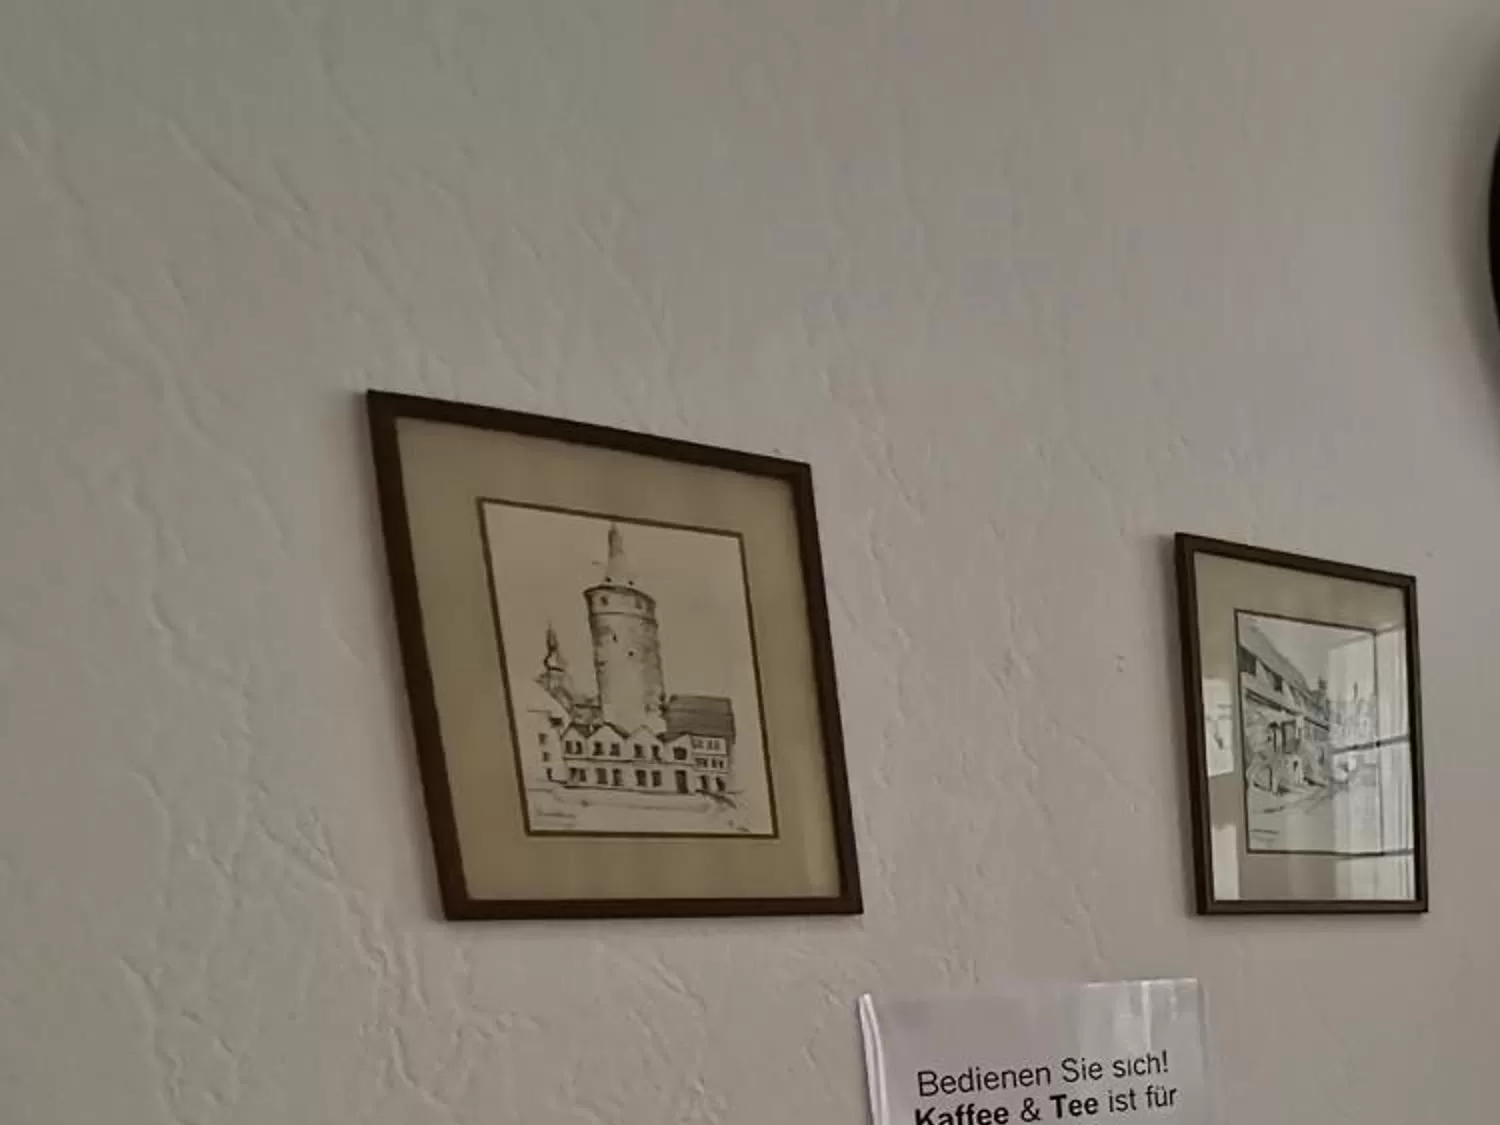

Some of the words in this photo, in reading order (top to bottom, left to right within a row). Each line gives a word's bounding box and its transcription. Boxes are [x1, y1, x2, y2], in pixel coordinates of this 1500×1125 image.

[917, 1064, 1052, 1098] Bedienen
[1060, 1056, 1104, 1084] Sie
[1112, 1050, 1170, 1078] sich!
[1019, 1096, 1042, 1123] &
[1049, 1093, 1099, 1120] Tee
[1107, 1088, 1138, 1114] ist
[1147, 1084, 1178, 1110] für
